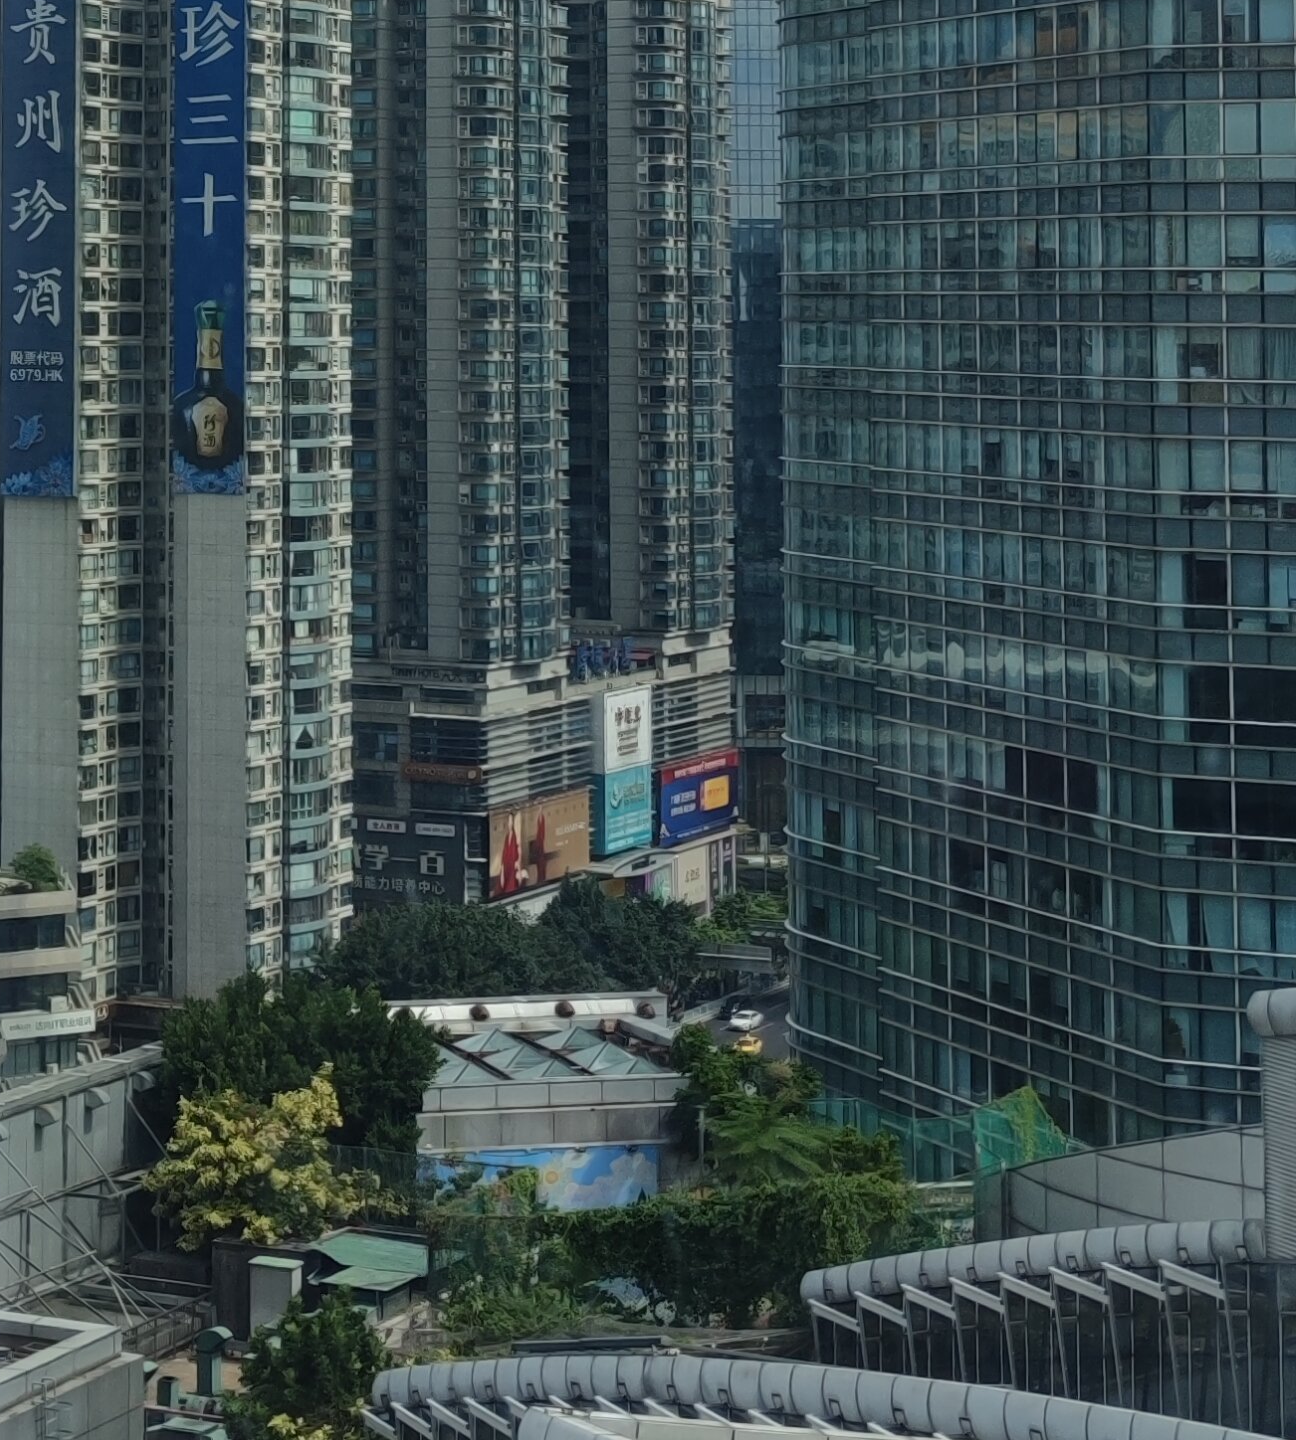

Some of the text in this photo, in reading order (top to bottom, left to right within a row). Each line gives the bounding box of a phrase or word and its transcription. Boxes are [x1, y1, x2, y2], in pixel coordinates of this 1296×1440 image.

[179, 0, 240, 238] 珍三十
[10, 350, 64, 366] 股票代码
[10, 368, 64, 382] 6979.HK
